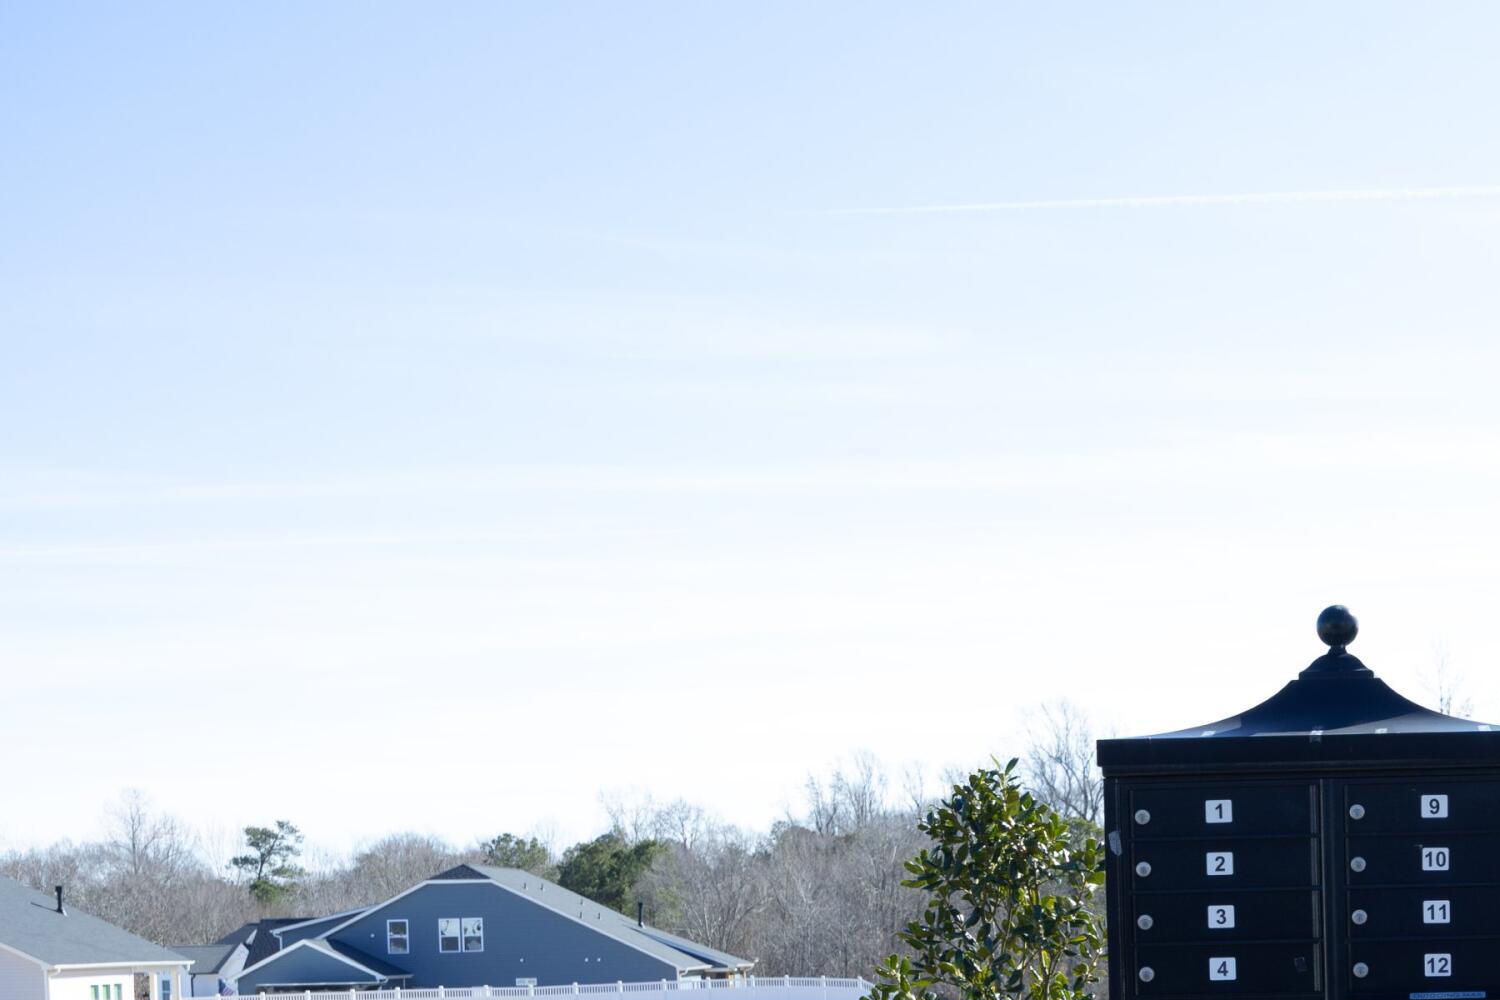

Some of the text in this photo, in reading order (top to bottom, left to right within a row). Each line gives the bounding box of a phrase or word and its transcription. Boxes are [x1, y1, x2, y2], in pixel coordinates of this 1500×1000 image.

[1213, 803, 1224, 820] 1
[1427, 798, 1442, 815] 9
[1213, 855, 1227, 872] 2
[1424, 850, 1447, 868] 10
[1215, 908, 1228, 925] 3
[1426, 903, 1447, 921] 11
[1215, 960, 1230, 977] 4
[1426, 956, 1449, 974] 12
